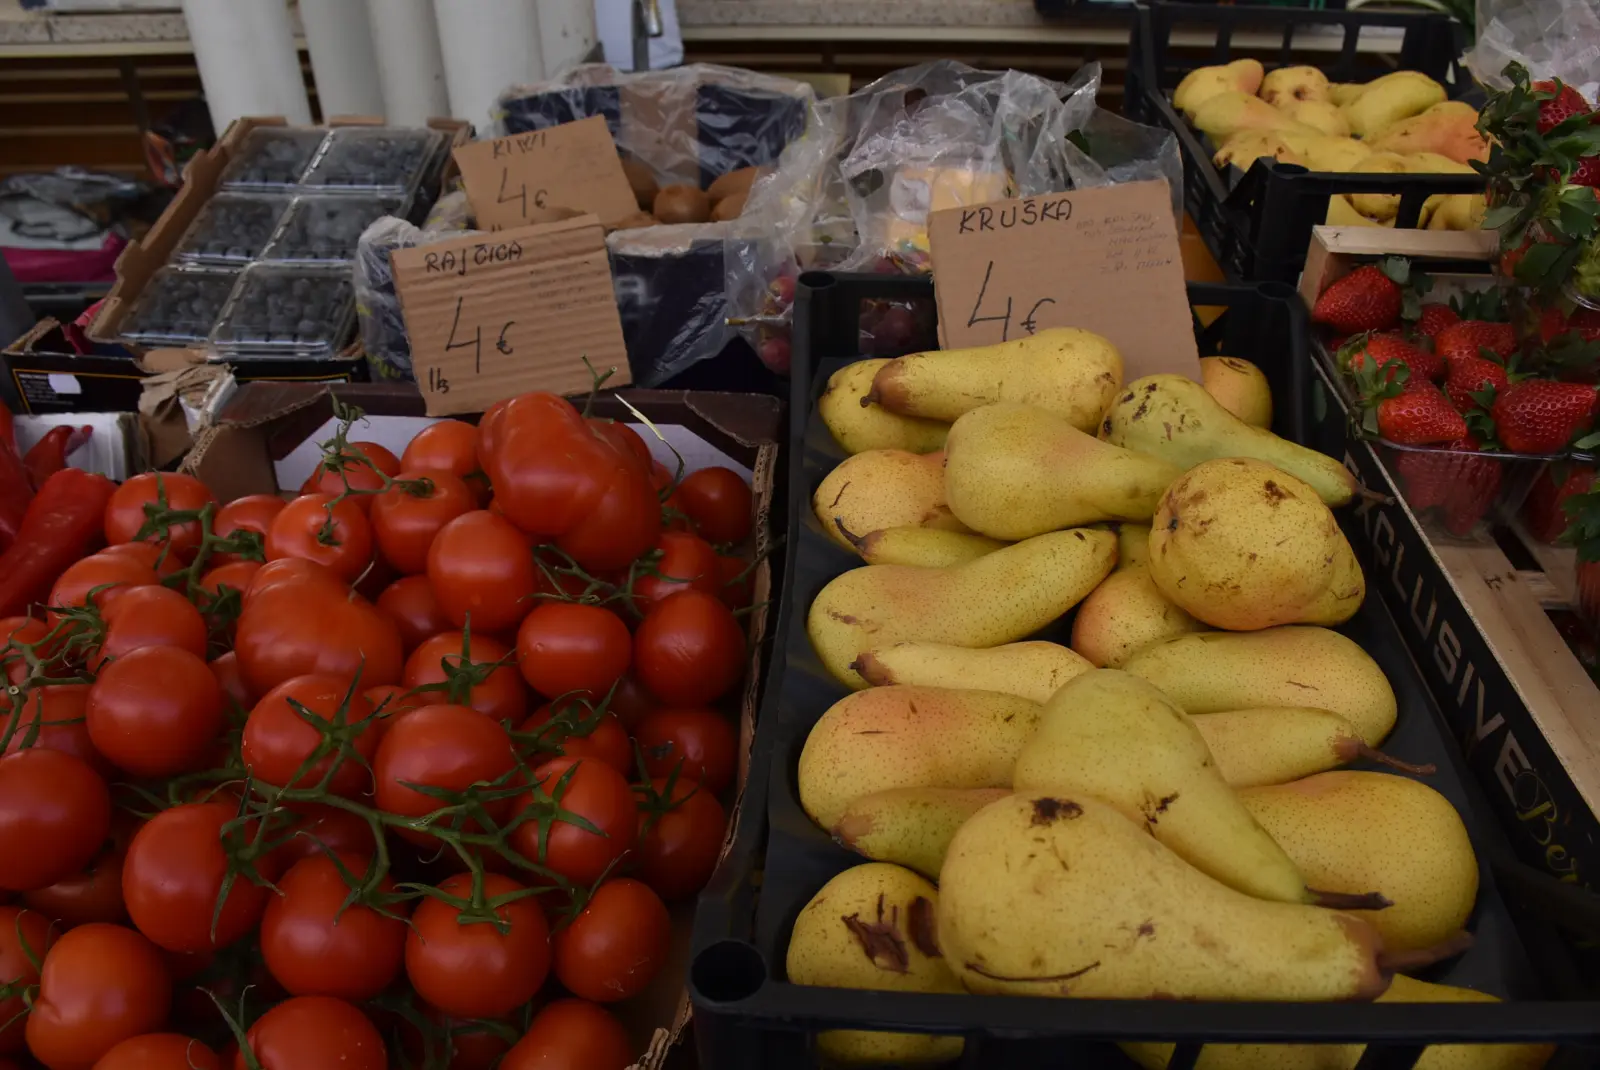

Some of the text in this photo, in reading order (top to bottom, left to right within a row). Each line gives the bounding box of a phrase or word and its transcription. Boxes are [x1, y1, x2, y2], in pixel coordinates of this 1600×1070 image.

[493, 131, 546, 159] KIWI
[959, 199, 1073, 234] KRUŠKA
[424, 240, 523, 276] RAJČICA
